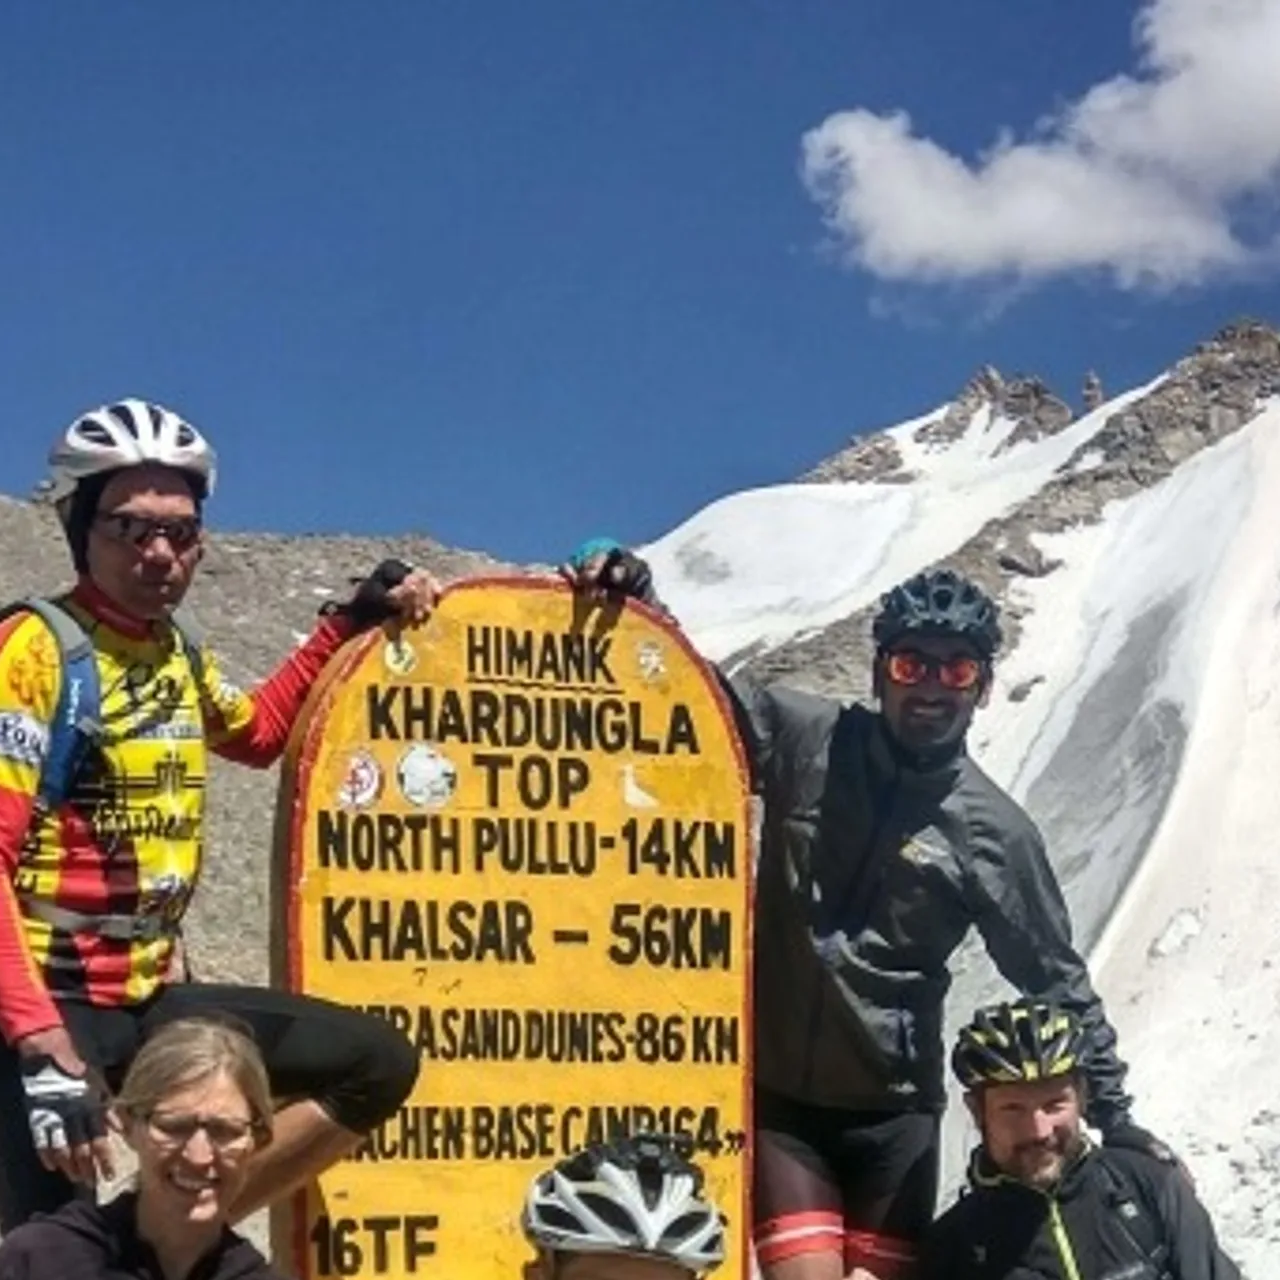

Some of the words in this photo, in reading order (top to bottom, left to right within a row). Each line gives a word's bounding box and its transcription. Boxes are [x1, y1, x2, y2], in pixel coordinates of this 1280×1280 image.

[467, 626, 616, 685] HIMANK
[367, 684, 700, 755] KHARDUNGLA
[472, 753, 589, 808] TOP
[317, 810, 460, 874] NORTH
[322, 896, 535, 964] KHALSAR
[609, 903, 731, 971] 56KM
[471, 1104, 555, 1160] BASE
